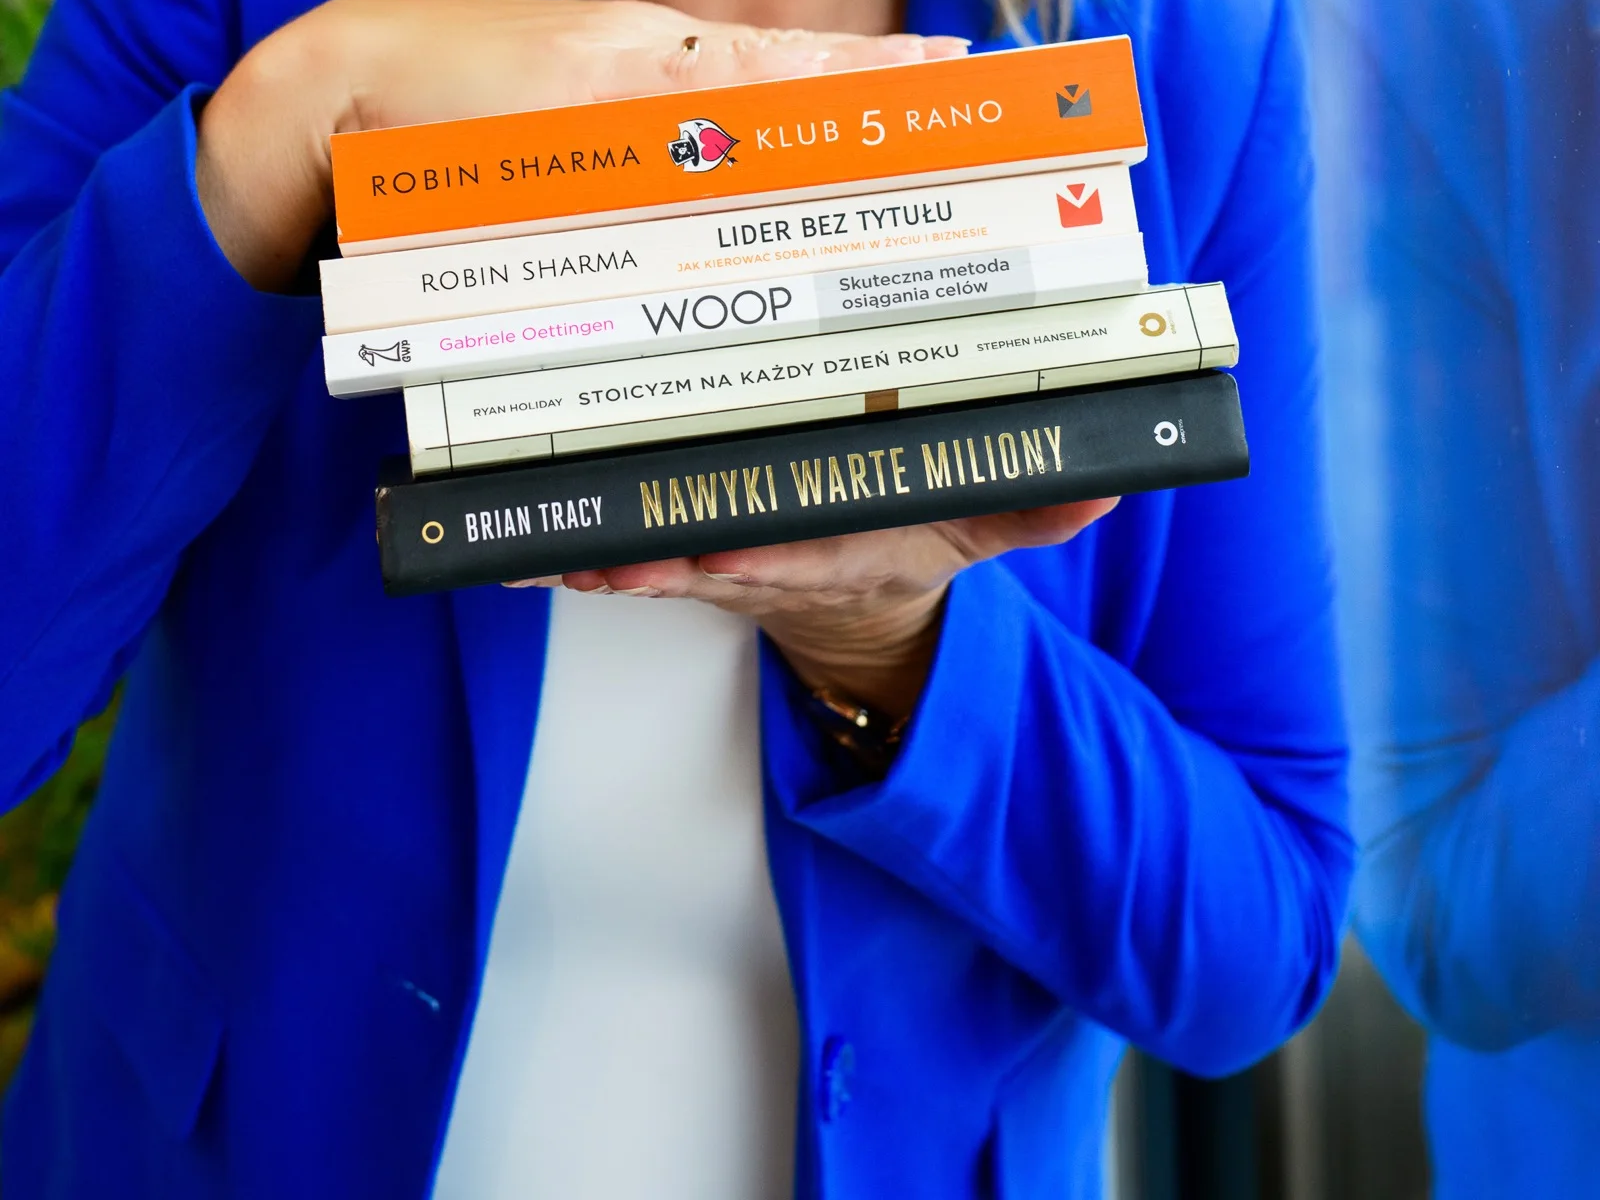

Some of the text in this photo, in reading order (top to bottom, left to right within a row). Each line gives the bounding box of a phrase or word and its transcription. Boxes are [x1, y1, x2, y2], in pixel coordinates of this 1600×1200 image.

[756, 100, 1003, 151] KLUB 5 RANO
[372, 145, 641, 197] ROBIN SHARMA
[718, 200, 954, 248] LIDER BEZ TYTUŁU
[422, 249, 638, 293] ROBIN SHARMA
[677, 260, 700, 273] JAK
[812, 246, 817, 256] I
[820, 242, 866, 256] INNYMI
[869, 239, 881, 249] W
[885, 234, 921, 248] ŻYCIU
[925, 234, 929, 243] I
[933, 227, 988, 241] BIZNESIE
[839, 259, 1010, 292] Skuteczna metoda
[842, 280, 989, 311] osiągania celów
[641, 286, 792, 336] WOOP
[401, 340, 411, 362] GWP
[439, 318, 614, 352] Gabriele Oettingen
[977, 327, 1108, 352] STEPHEN HANSELMAN
[578, 344, 960, 406] STOICYZM NA KAŻDY DZIEŃ ROKU
[473, 398, 563, 417] RYAN HOLIDAY
[640, 425, 1063, 528] NAWYKI WARTE MILIONY
[465, 496, 602, 543] BRIAN TRACY
